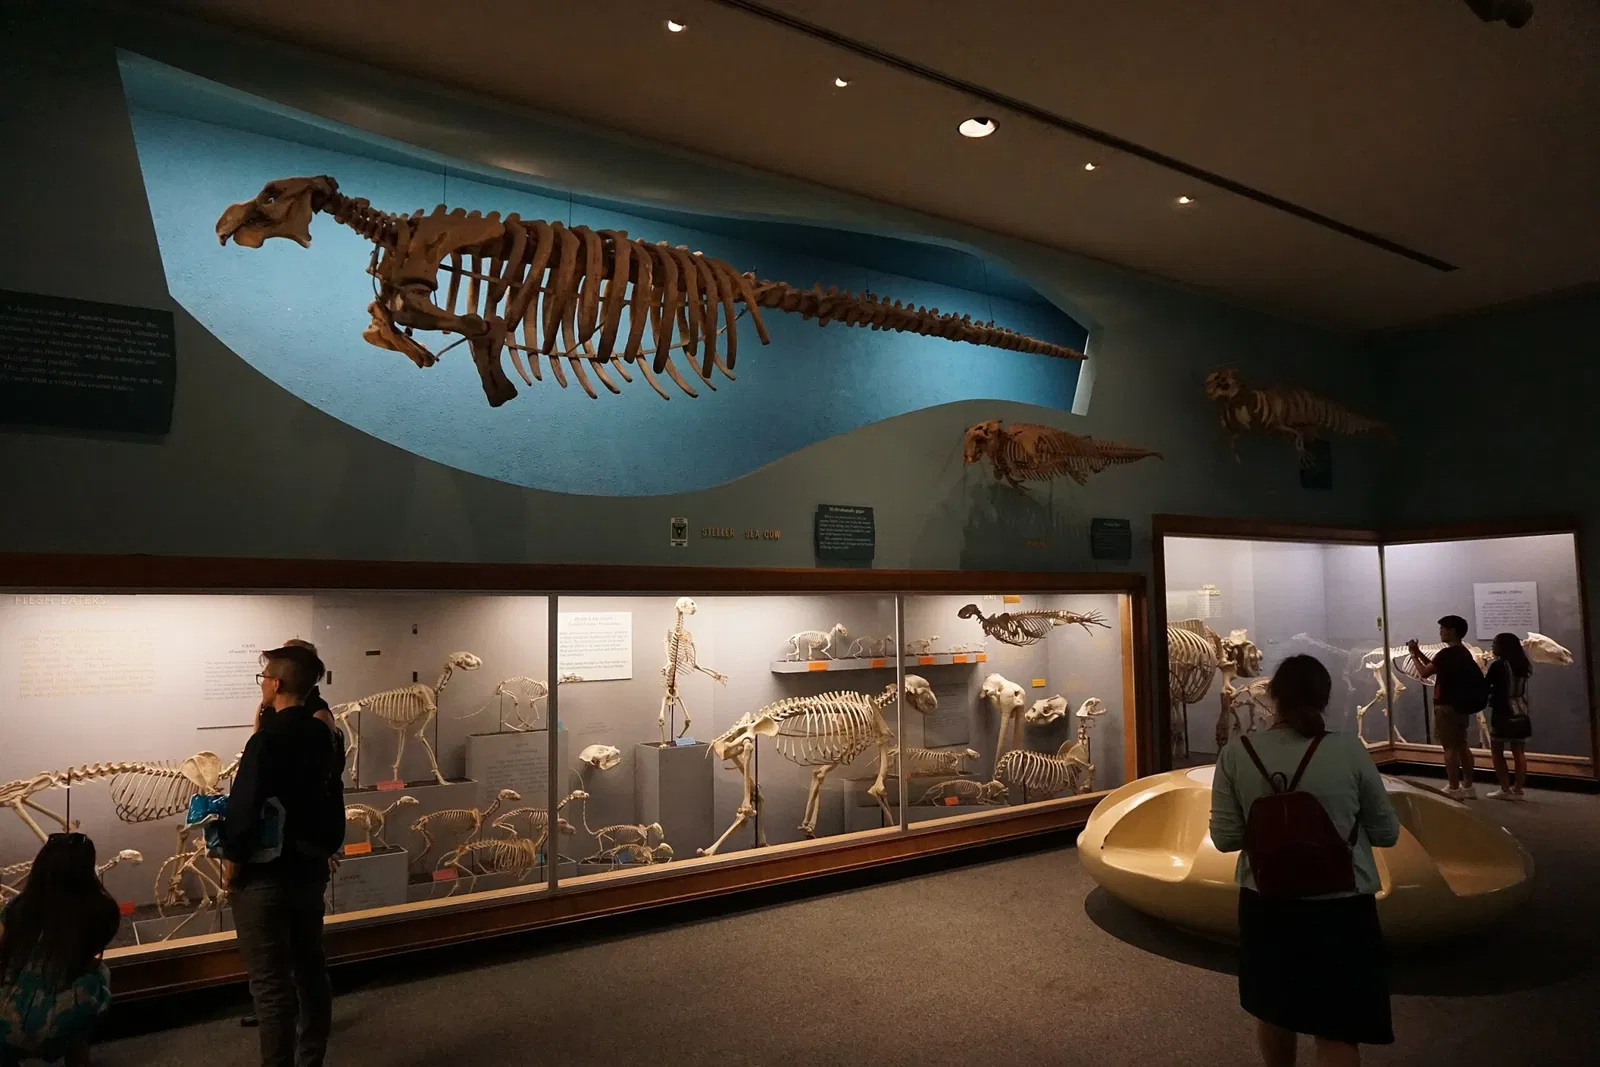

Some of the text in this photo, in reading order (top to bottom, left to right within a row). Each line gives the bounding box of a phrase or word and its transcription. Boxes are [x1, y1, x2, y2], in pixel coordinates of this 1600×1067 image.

[701, 527, 782, 540] STELLER SEA COW
